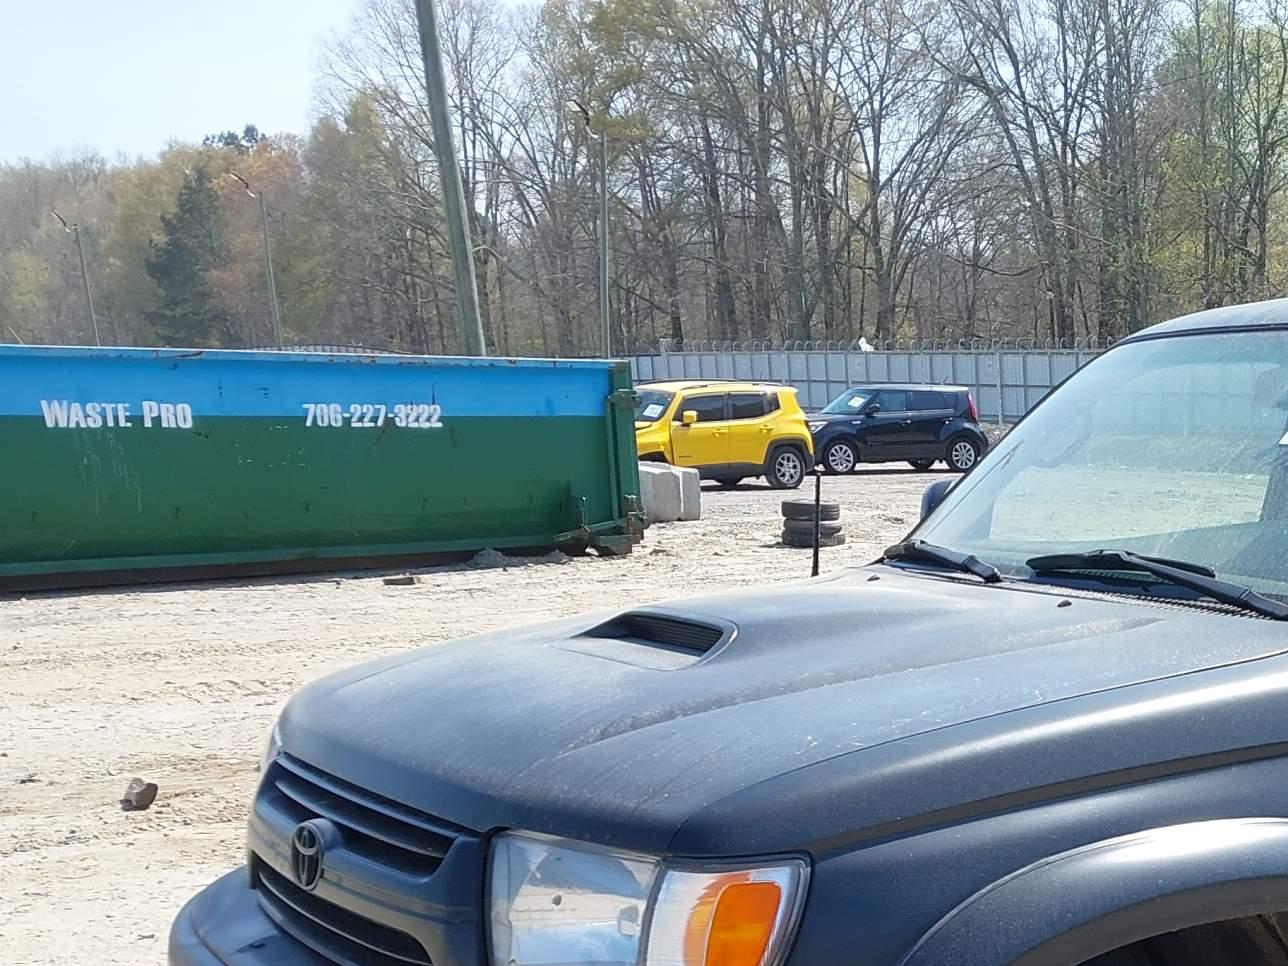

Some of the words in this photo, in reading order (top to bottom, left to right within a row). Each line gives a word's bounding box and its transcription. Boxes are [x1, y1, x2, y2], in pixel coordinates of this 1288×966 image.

[40, 399, 132, 428] WASTE
[142, 401, 193, 429] PRO
[302, 403, 444, 429] 706-227-3222
